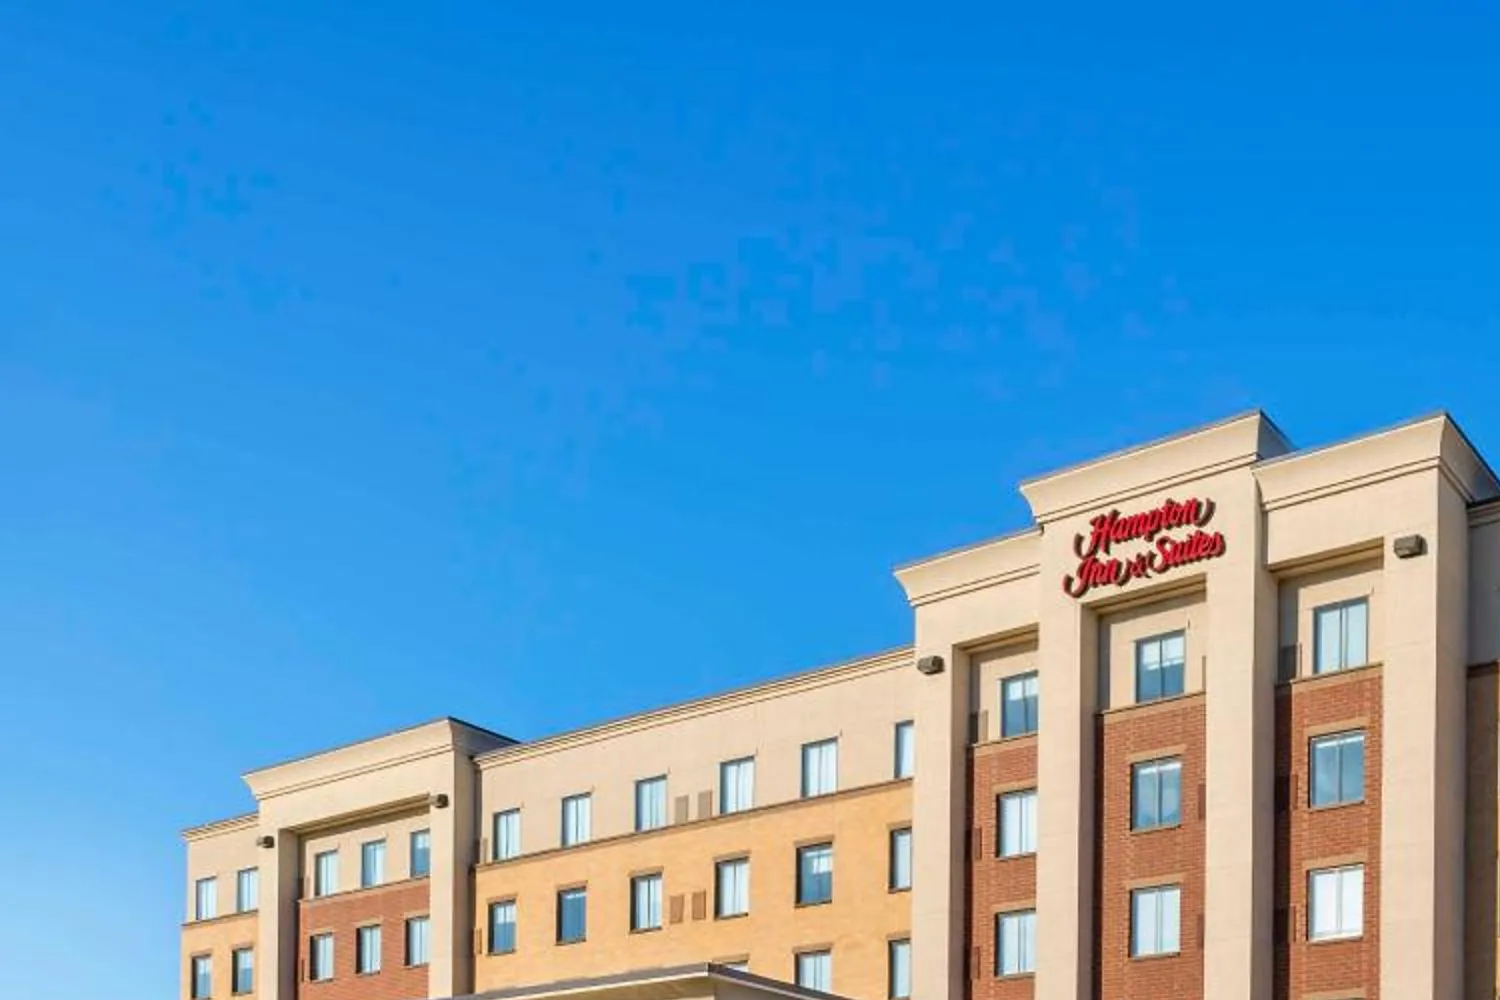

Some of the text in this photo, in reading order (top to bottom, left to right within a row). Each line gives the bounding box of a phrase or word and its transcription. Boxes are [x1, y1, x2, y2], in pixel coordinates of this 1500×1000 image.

[1074, 498, 1216, 559] Hampton
[1063, 555, 1131, 598] Inn
[1153, 530, 1226, 573] Suites
